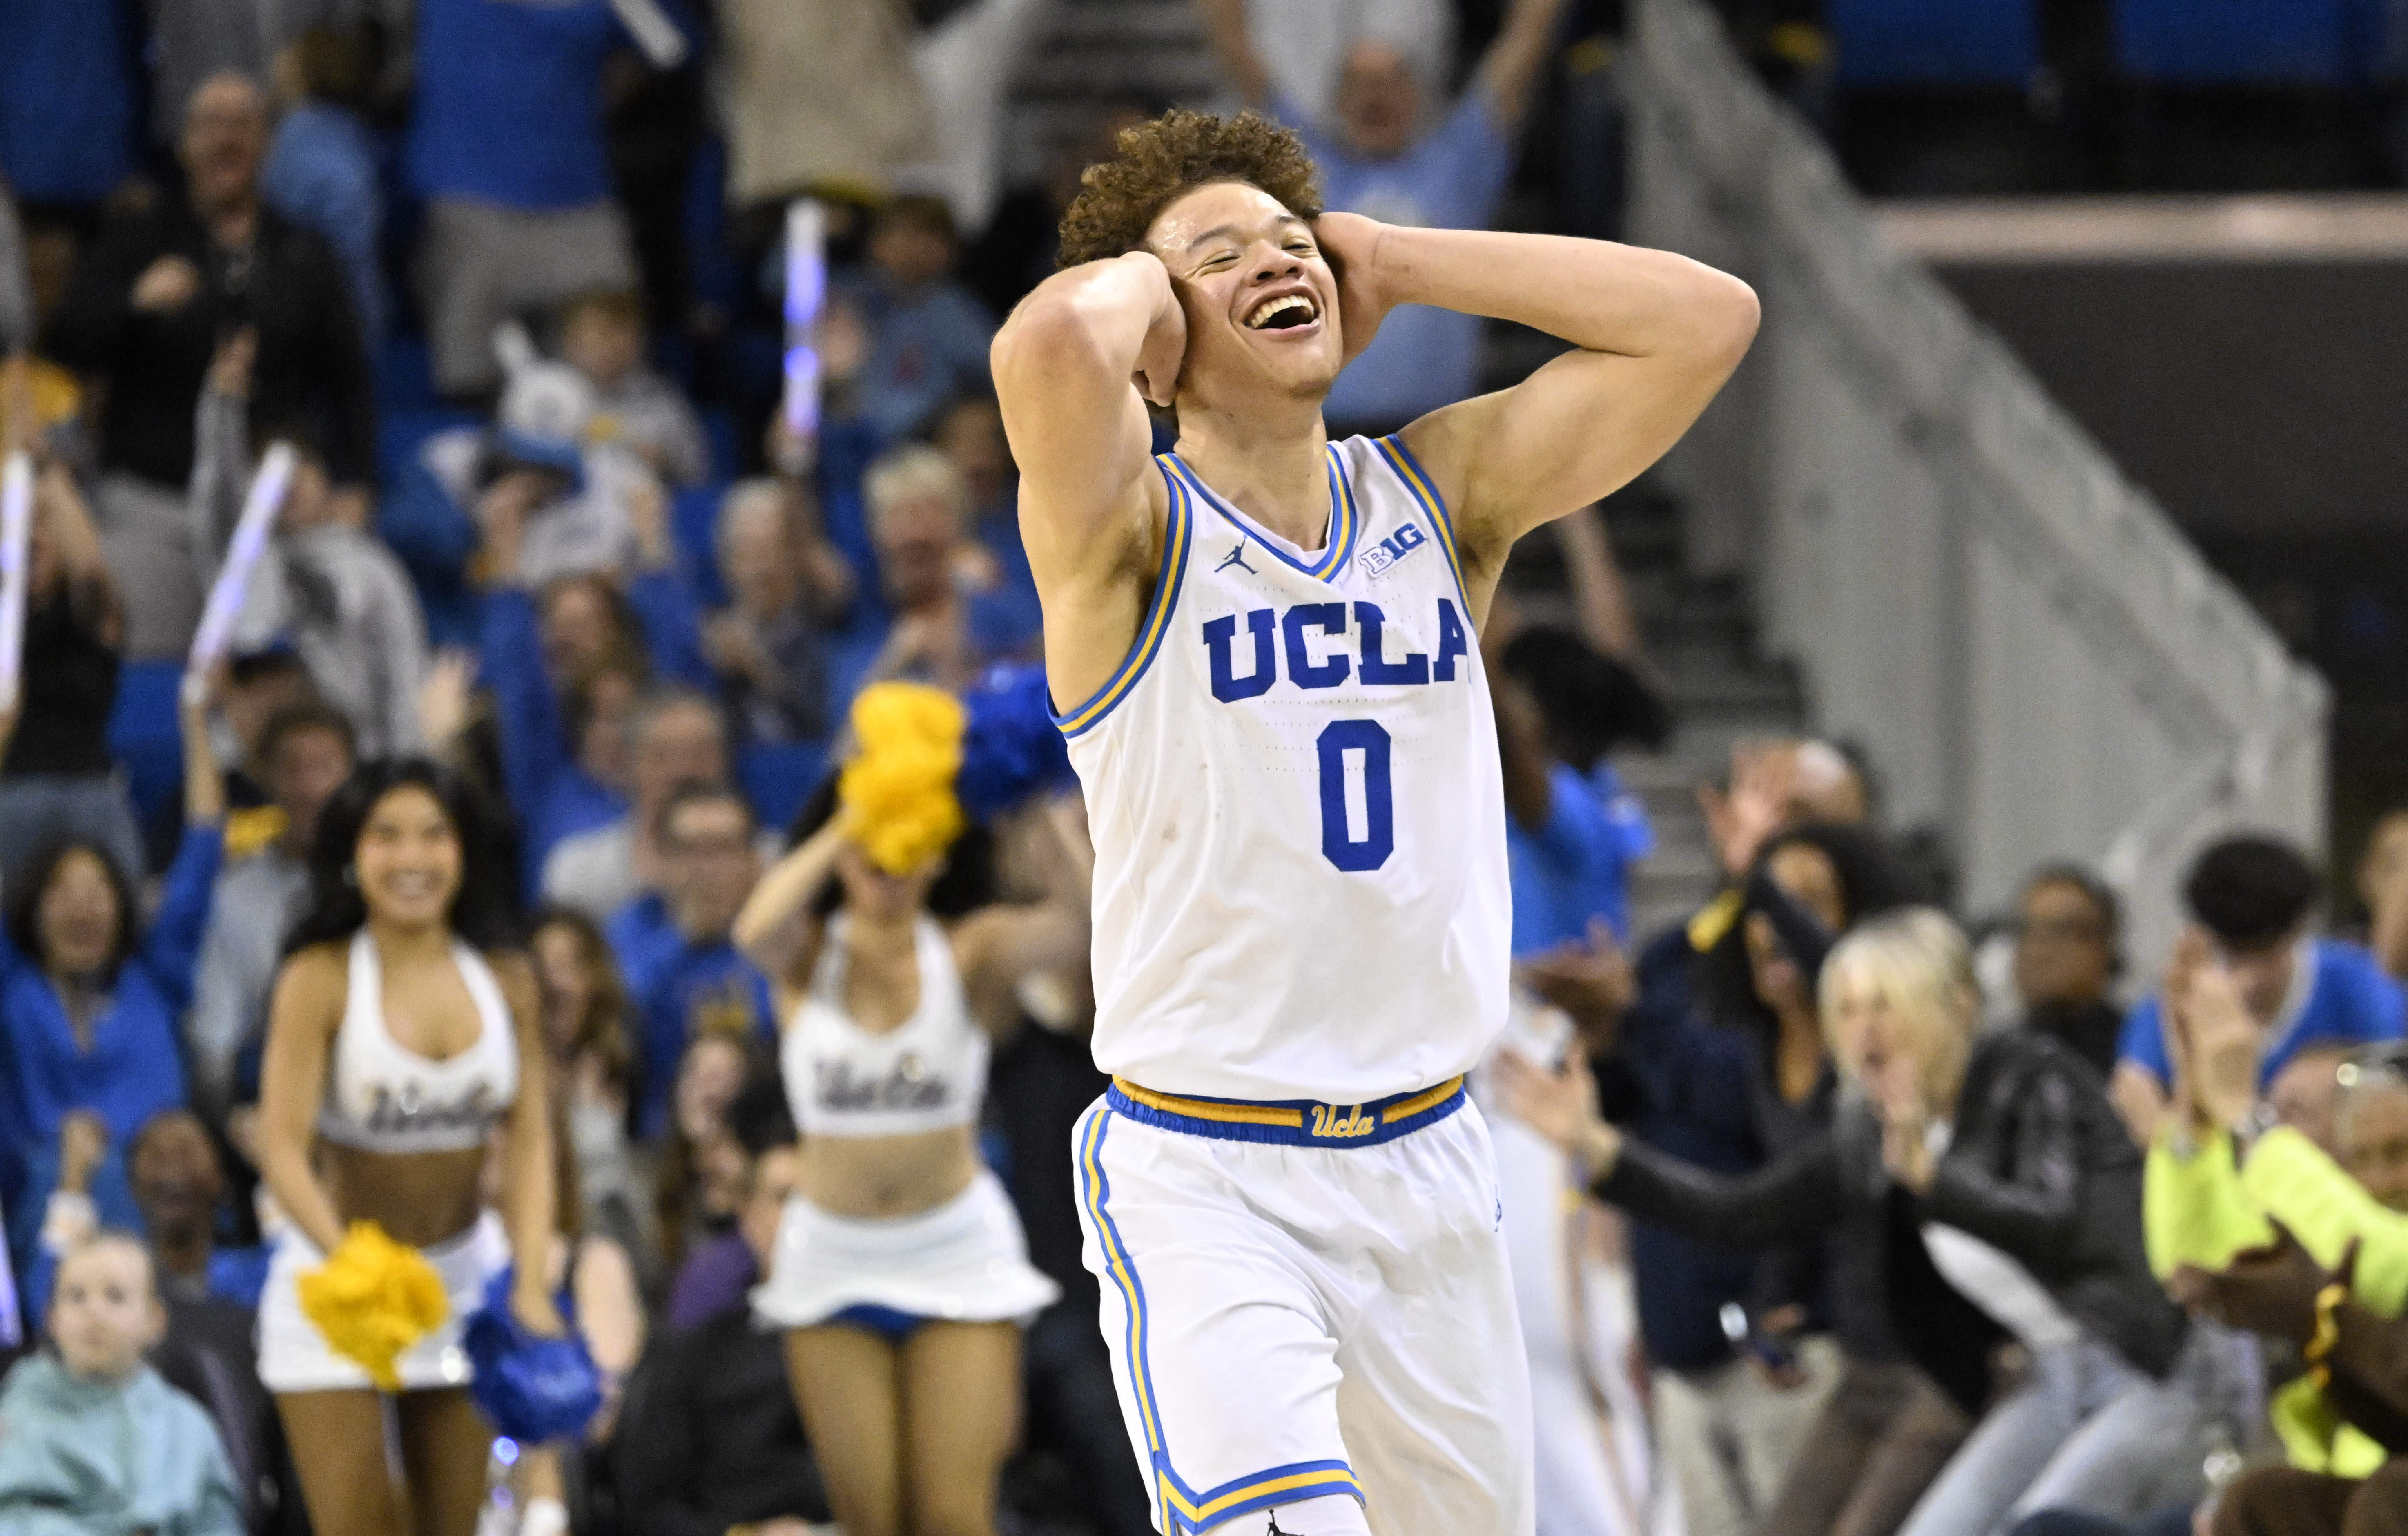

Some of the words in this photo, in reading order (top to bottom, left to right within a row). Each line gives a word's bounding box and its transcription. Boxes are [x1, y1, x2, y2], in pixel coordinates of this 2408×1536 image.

[1203, 598, 1468, 703] UCLA
[1316, 719, 1394, 872] 0
[1311, 1104, 1374, 1137] Ucla
